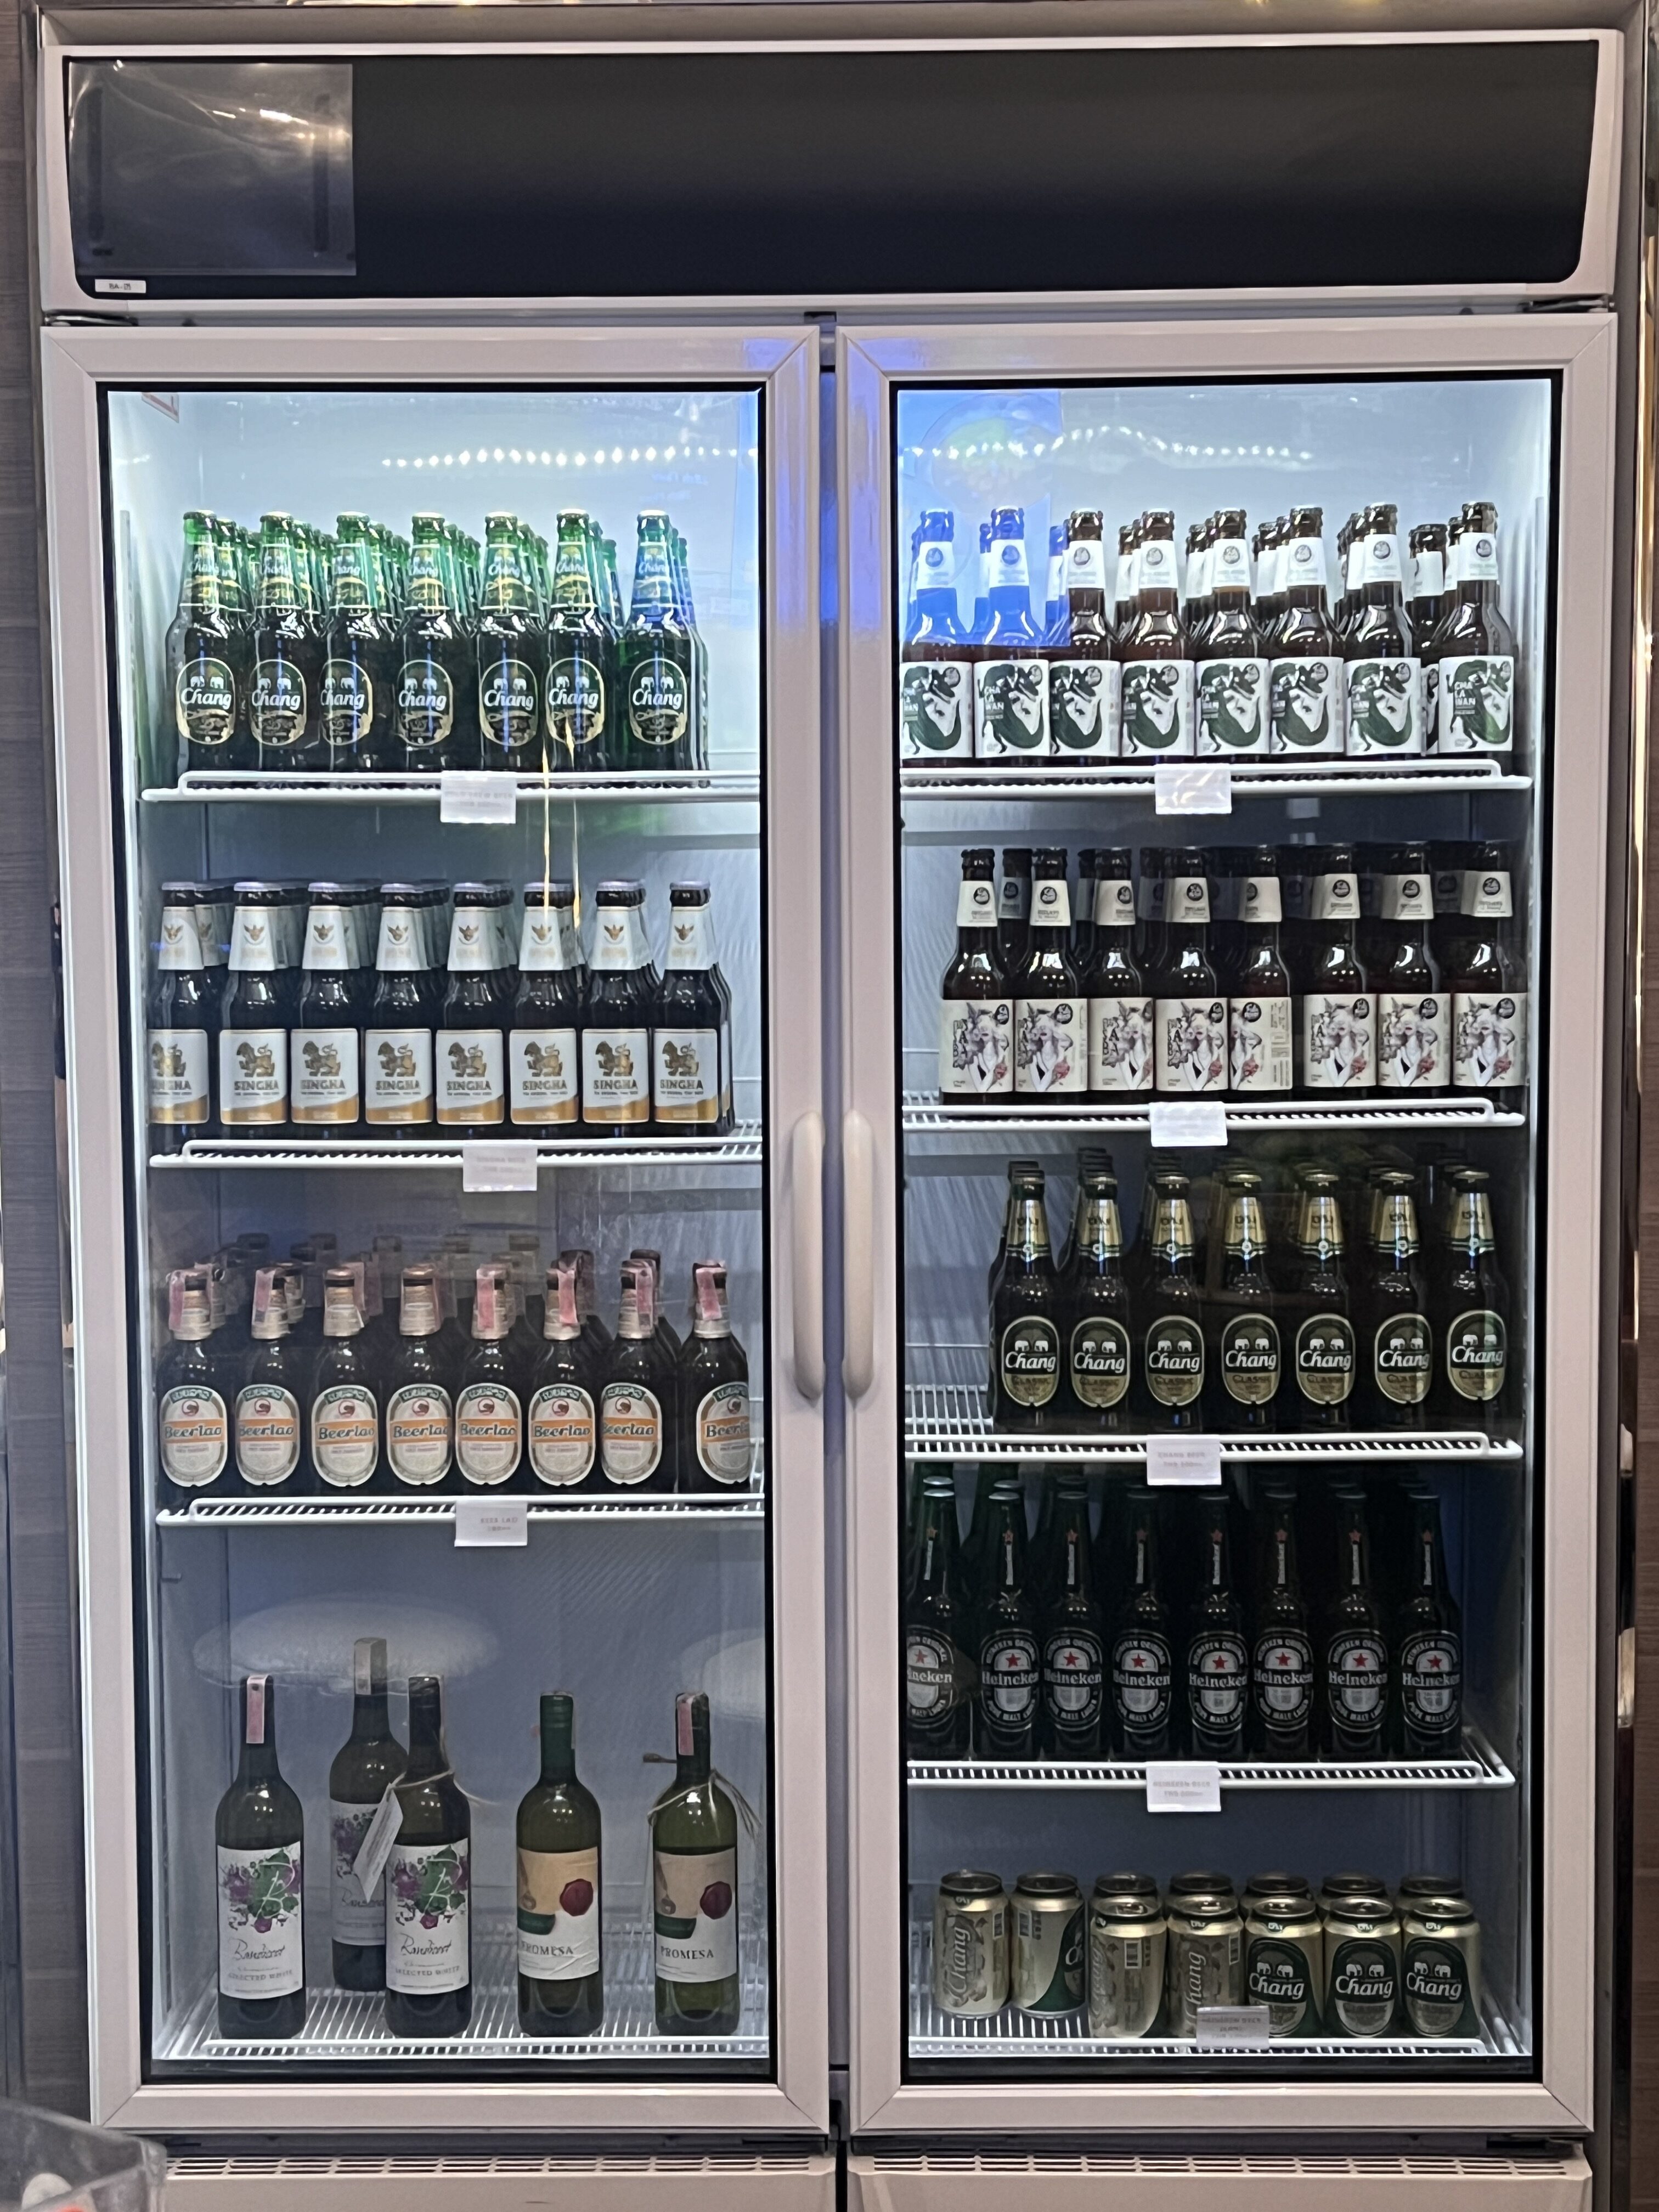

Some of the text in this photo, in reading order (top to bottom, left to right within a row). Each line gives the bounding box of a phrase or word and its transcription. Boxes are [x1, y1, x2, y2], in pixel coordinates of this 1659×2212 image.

[180, 688, 232, 710] Chang
[251, 690, 301, 710] Chang
[320, 690, 365, 709] Chang
[399, 689, 447, 709] Chang
[484, 690, 534, 709] Chang
[549, 688, 599, 709] Chang
[632, 688, 682, 709] Chang
[234, 1080, 279, 1091] SINGHA
[301, 1080, 346, 1090] SINGHA
[376, 1080, 421, 1091] SINGHA
[447, 1080, 492, 1091] SINGHA
[522, 1080, 568, 1091] SINGHA
[593, 1079, 638, 1090] SINGHA
[660, 1079, 704, 1090] SINGHA
[1005, 1351, 1056, 1372] Chang
[1074, 1352, 1125, 1374] Chang
[1149, 1351, 1200, 1372] Chang
[1226, 1350, 1277, 1370] Chang
[1300, 1350, 1352, 1370] Chang
[1379, 1350, 1430, 1369] Chang
[1452, 1346, 1503, 1365] Chang
[165, 1425, 222, 1438] Beerlao
[319, 1425, 375, 1440] Beerlao
[461, 1424, 516, 1436] Beerlao
[534, 1424, 590, 1437] Beerlao
[603, 1424, 654, 1436] eerlao
[661, 1945, 714, 1960] PROMESA
[946, 1927, 970, 1994] Chang
[1249, 1972, 1305, 2000] Chang
[1335, 1975, 1393, 1999] Chang
[1406, 1972, 1462, 2001] Chang
